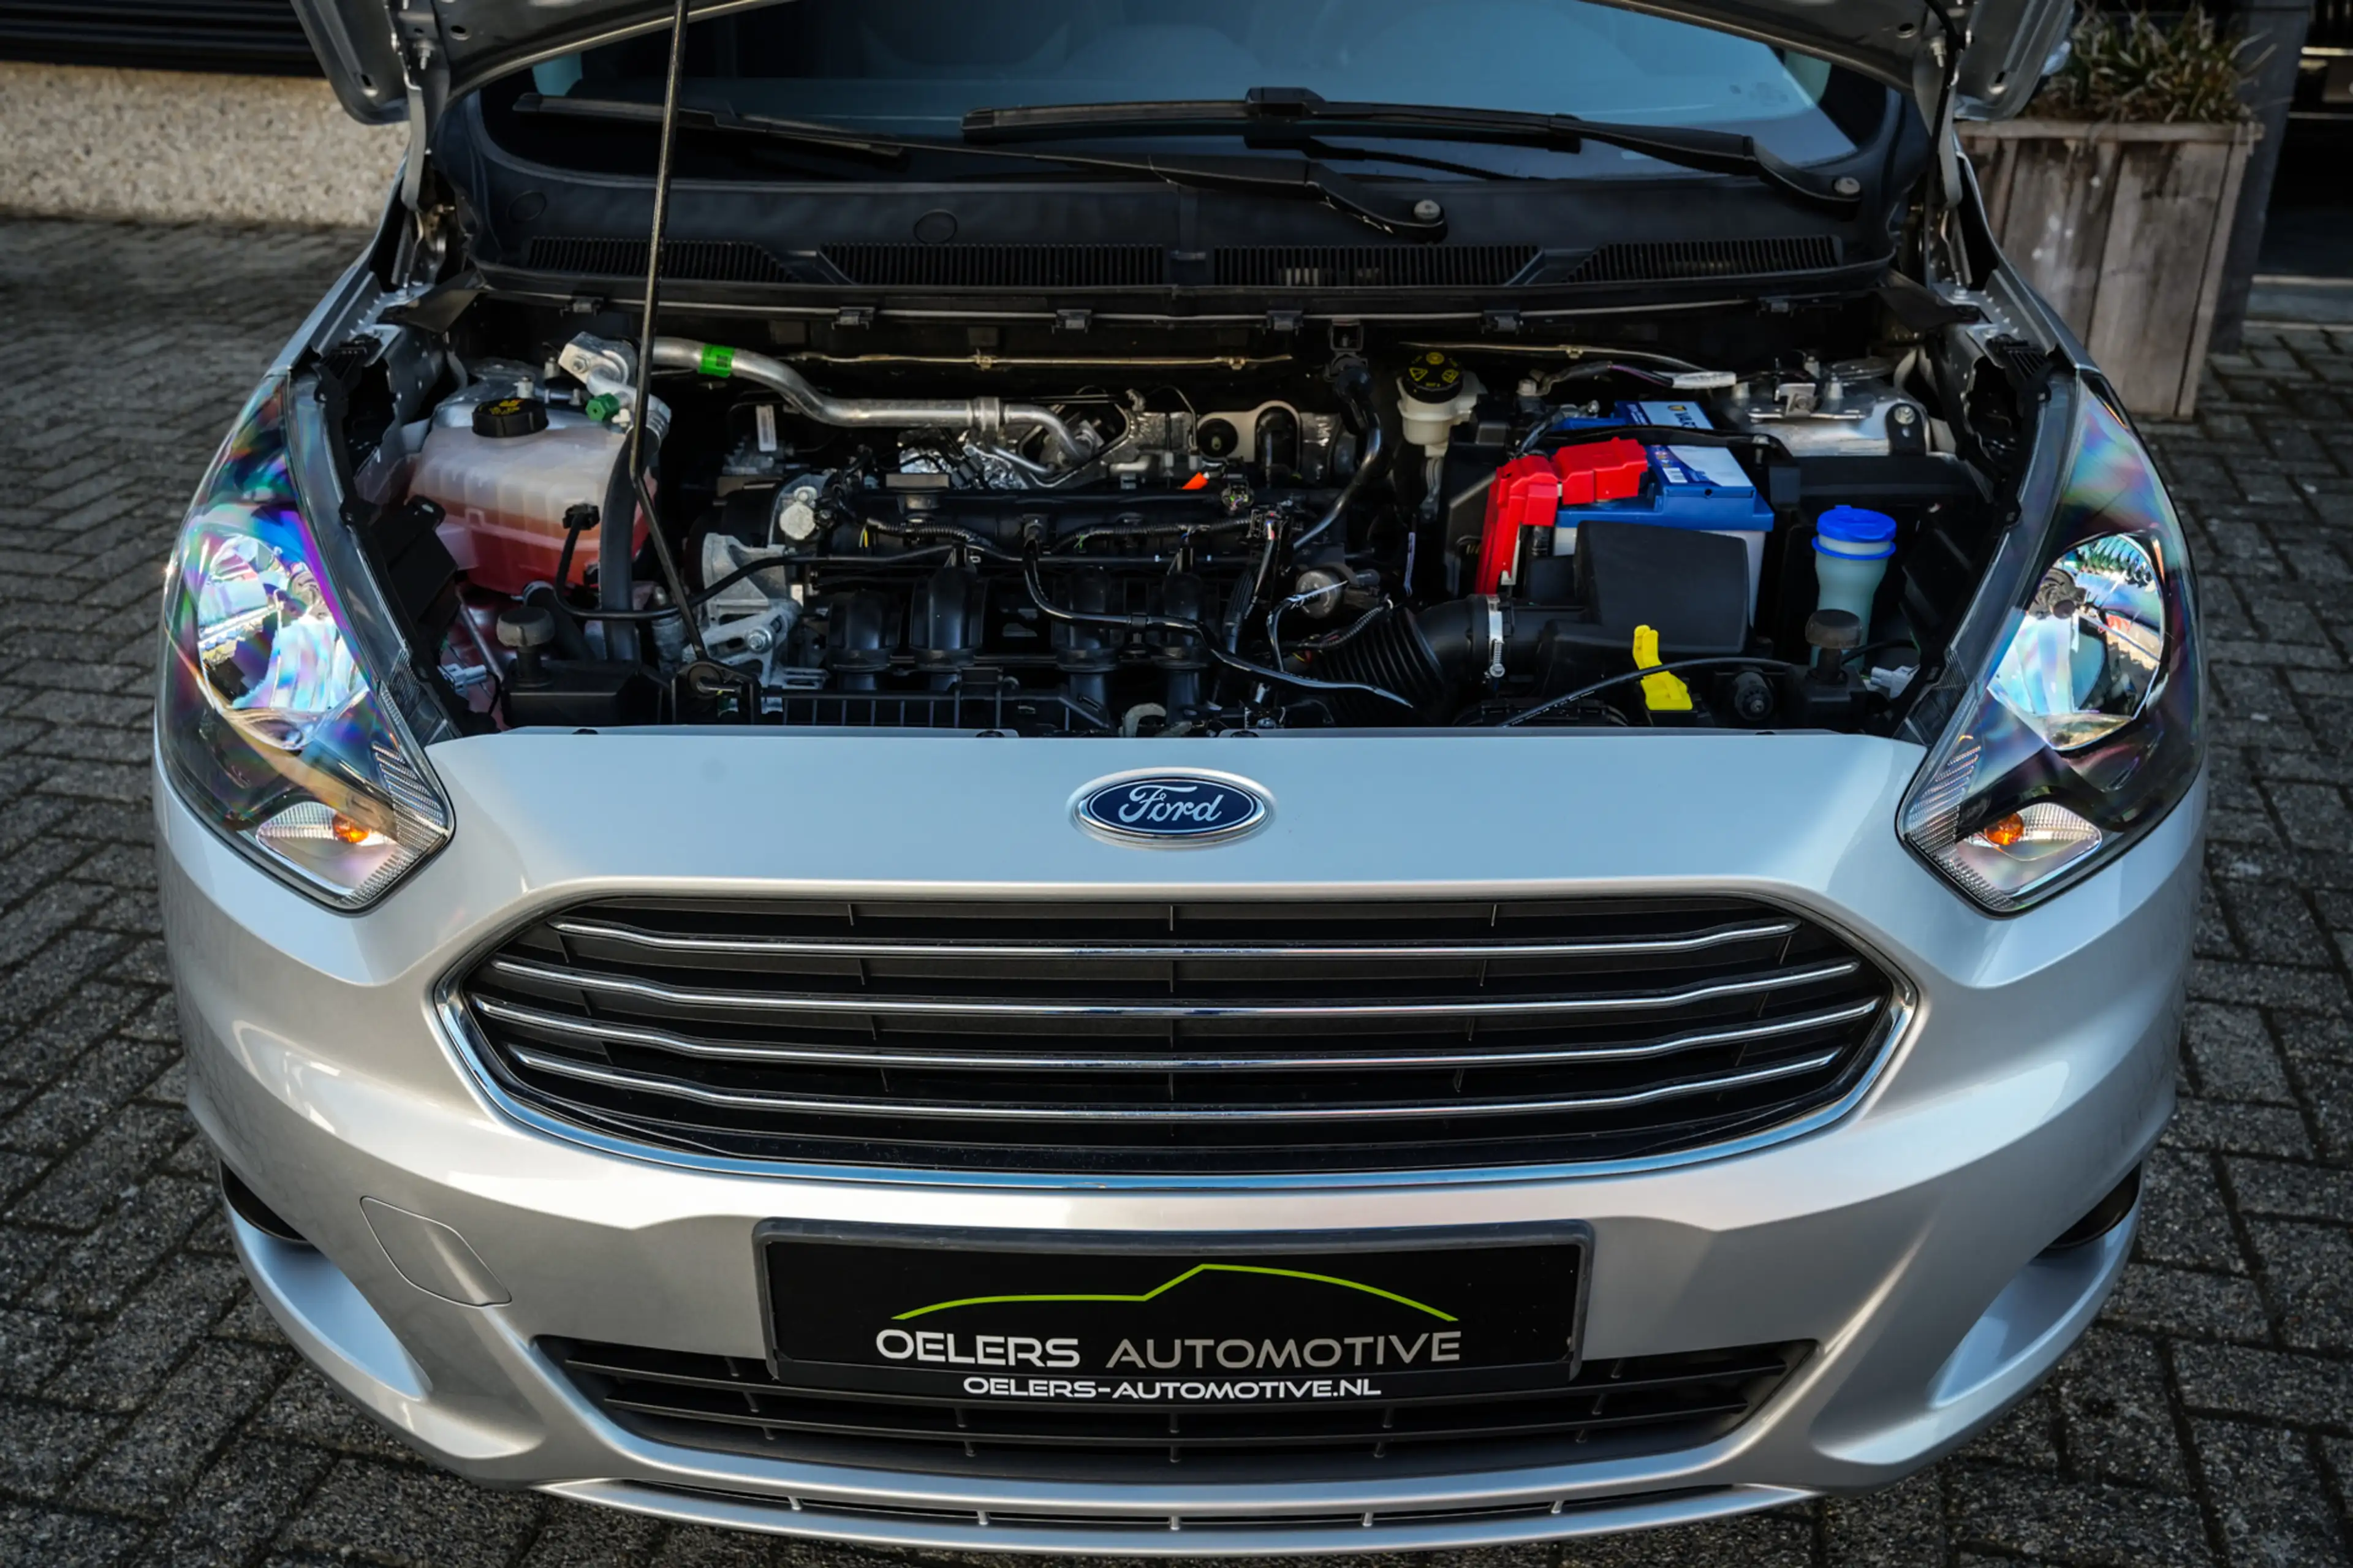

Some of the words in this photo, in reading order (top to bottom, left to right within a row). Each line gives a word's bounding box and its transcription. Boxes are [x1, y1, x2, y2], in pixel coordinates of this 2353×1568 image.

[1118, 784, 1224, 824] Ford
[876, 1328, 1081, 1368] OELERS
[1105, 1330, 1462, 1369] AUTOMOTIVE
[963, 1376, 1382, 1399] OELERS-AUTOMOTIVE.NL
